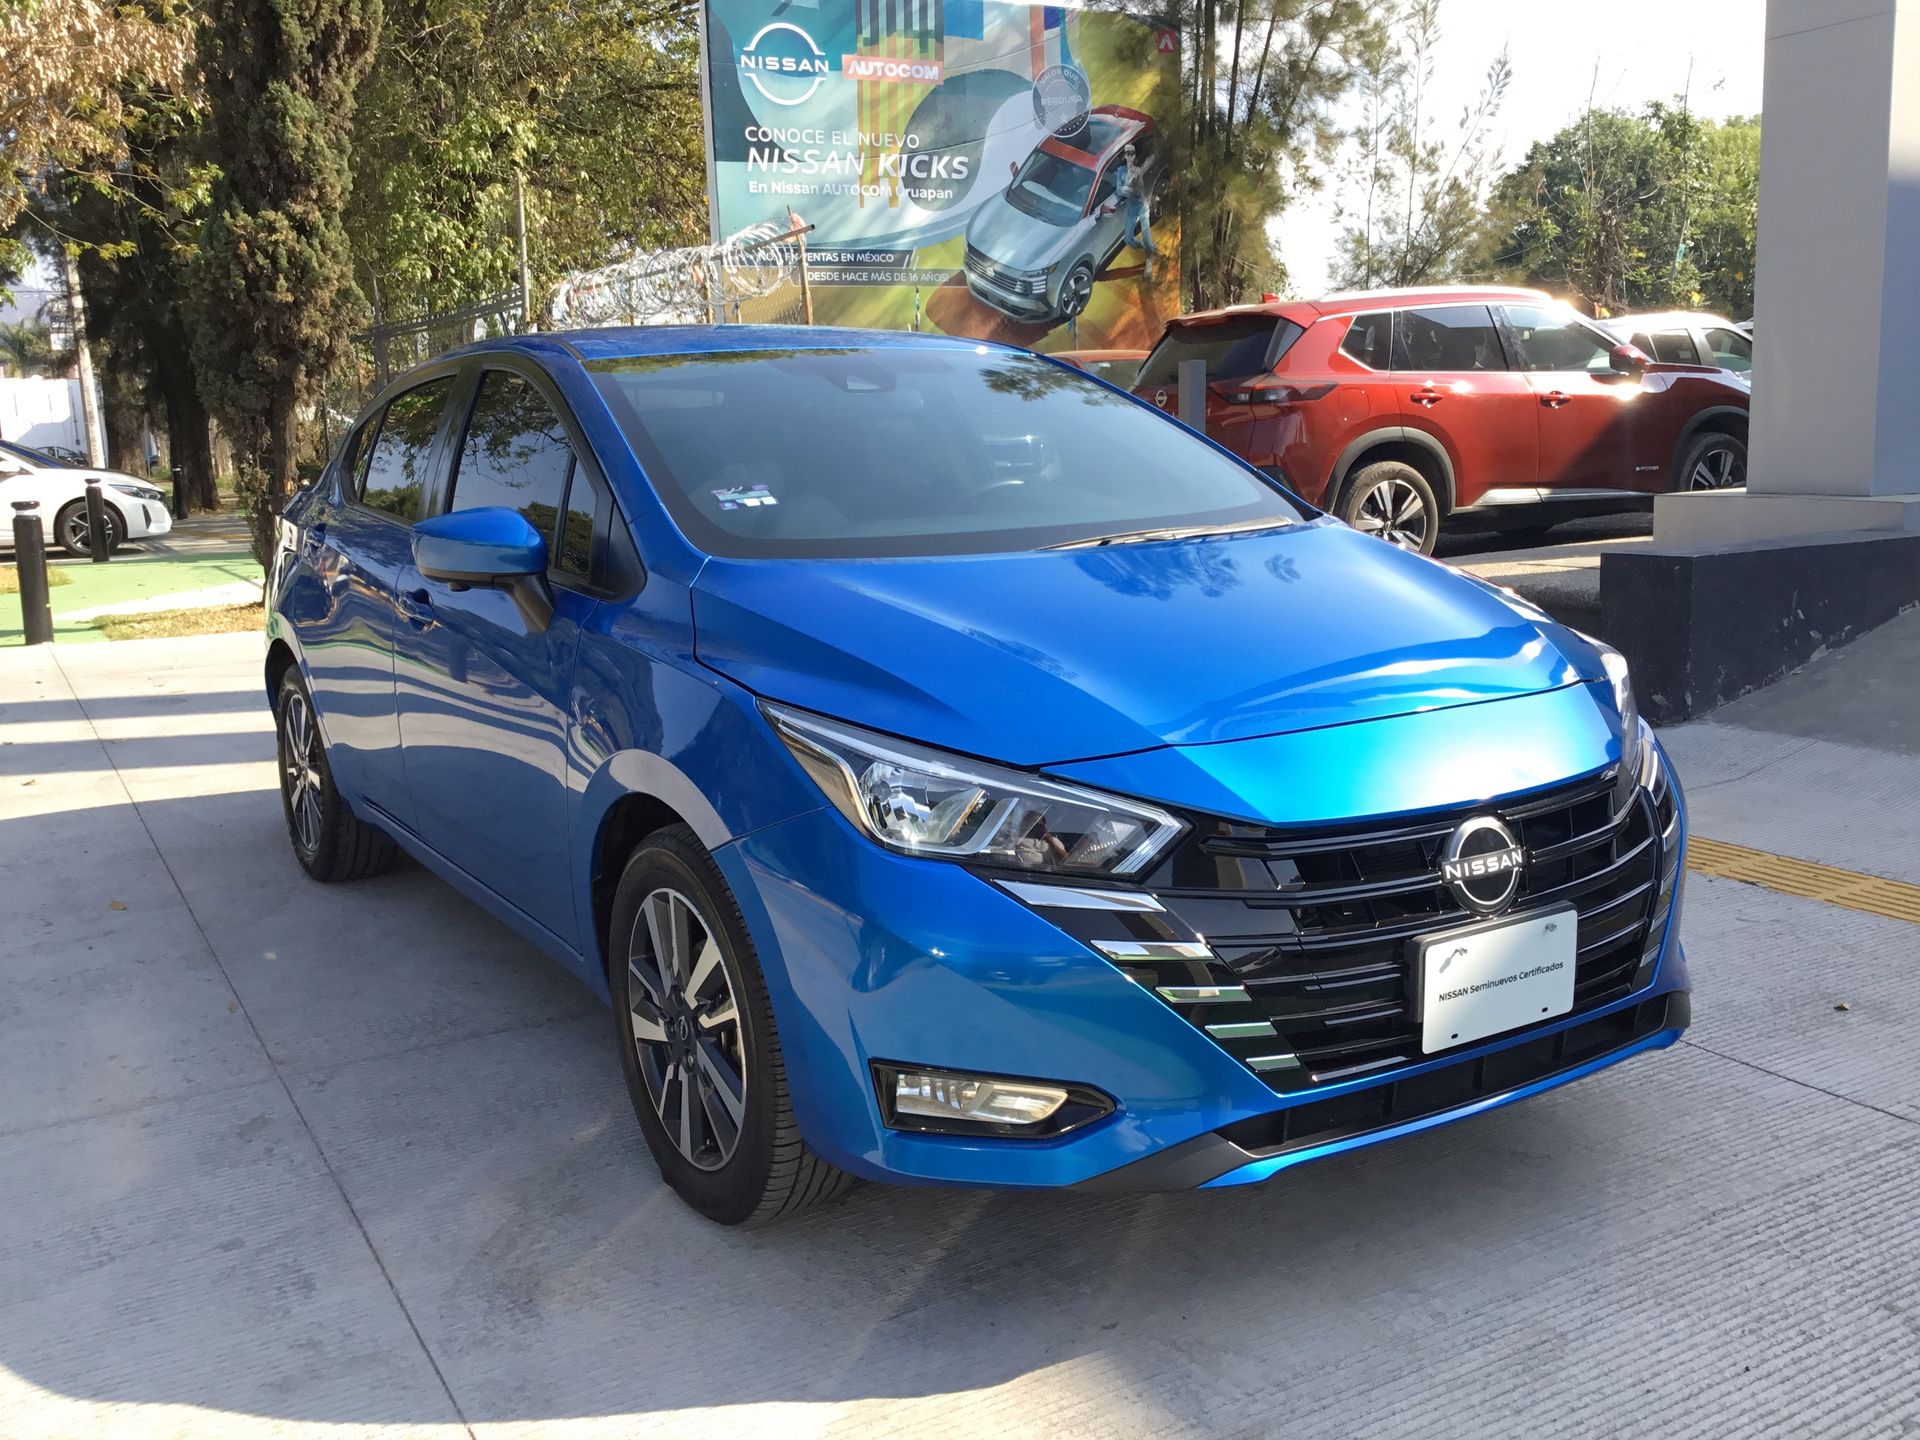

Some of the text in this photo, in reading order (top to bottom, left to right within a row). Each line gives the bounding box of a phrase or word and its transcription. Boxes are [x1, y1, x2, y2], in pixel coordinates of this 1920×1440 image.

[740, 54, 829, 74] NISSAN
[848, 60, 939, 80] AUTOCOM
[744, 126, 920, 149] CONOCE EL NUEVO
[747, 147, 970, 180] NISSAN KICKS
[749, 180, 953, 201] En Nissan AUTOCOM Uruapan
[841, 253, 854, 263] EN
[856, 252, 894, 264] MÉXICO
[807, 272, 840, 281] DESDE
[842, 272, 869, 282] HACE
[870, 271, 892, 282] MÁS
[893, 272, 907, 282] DE
[909, 272, 918, 282] 16
[1445, 850, 1522, 879] NISSAN
[1438, 961, 1564, 1002] NISSAN Seminuevos Certificados
